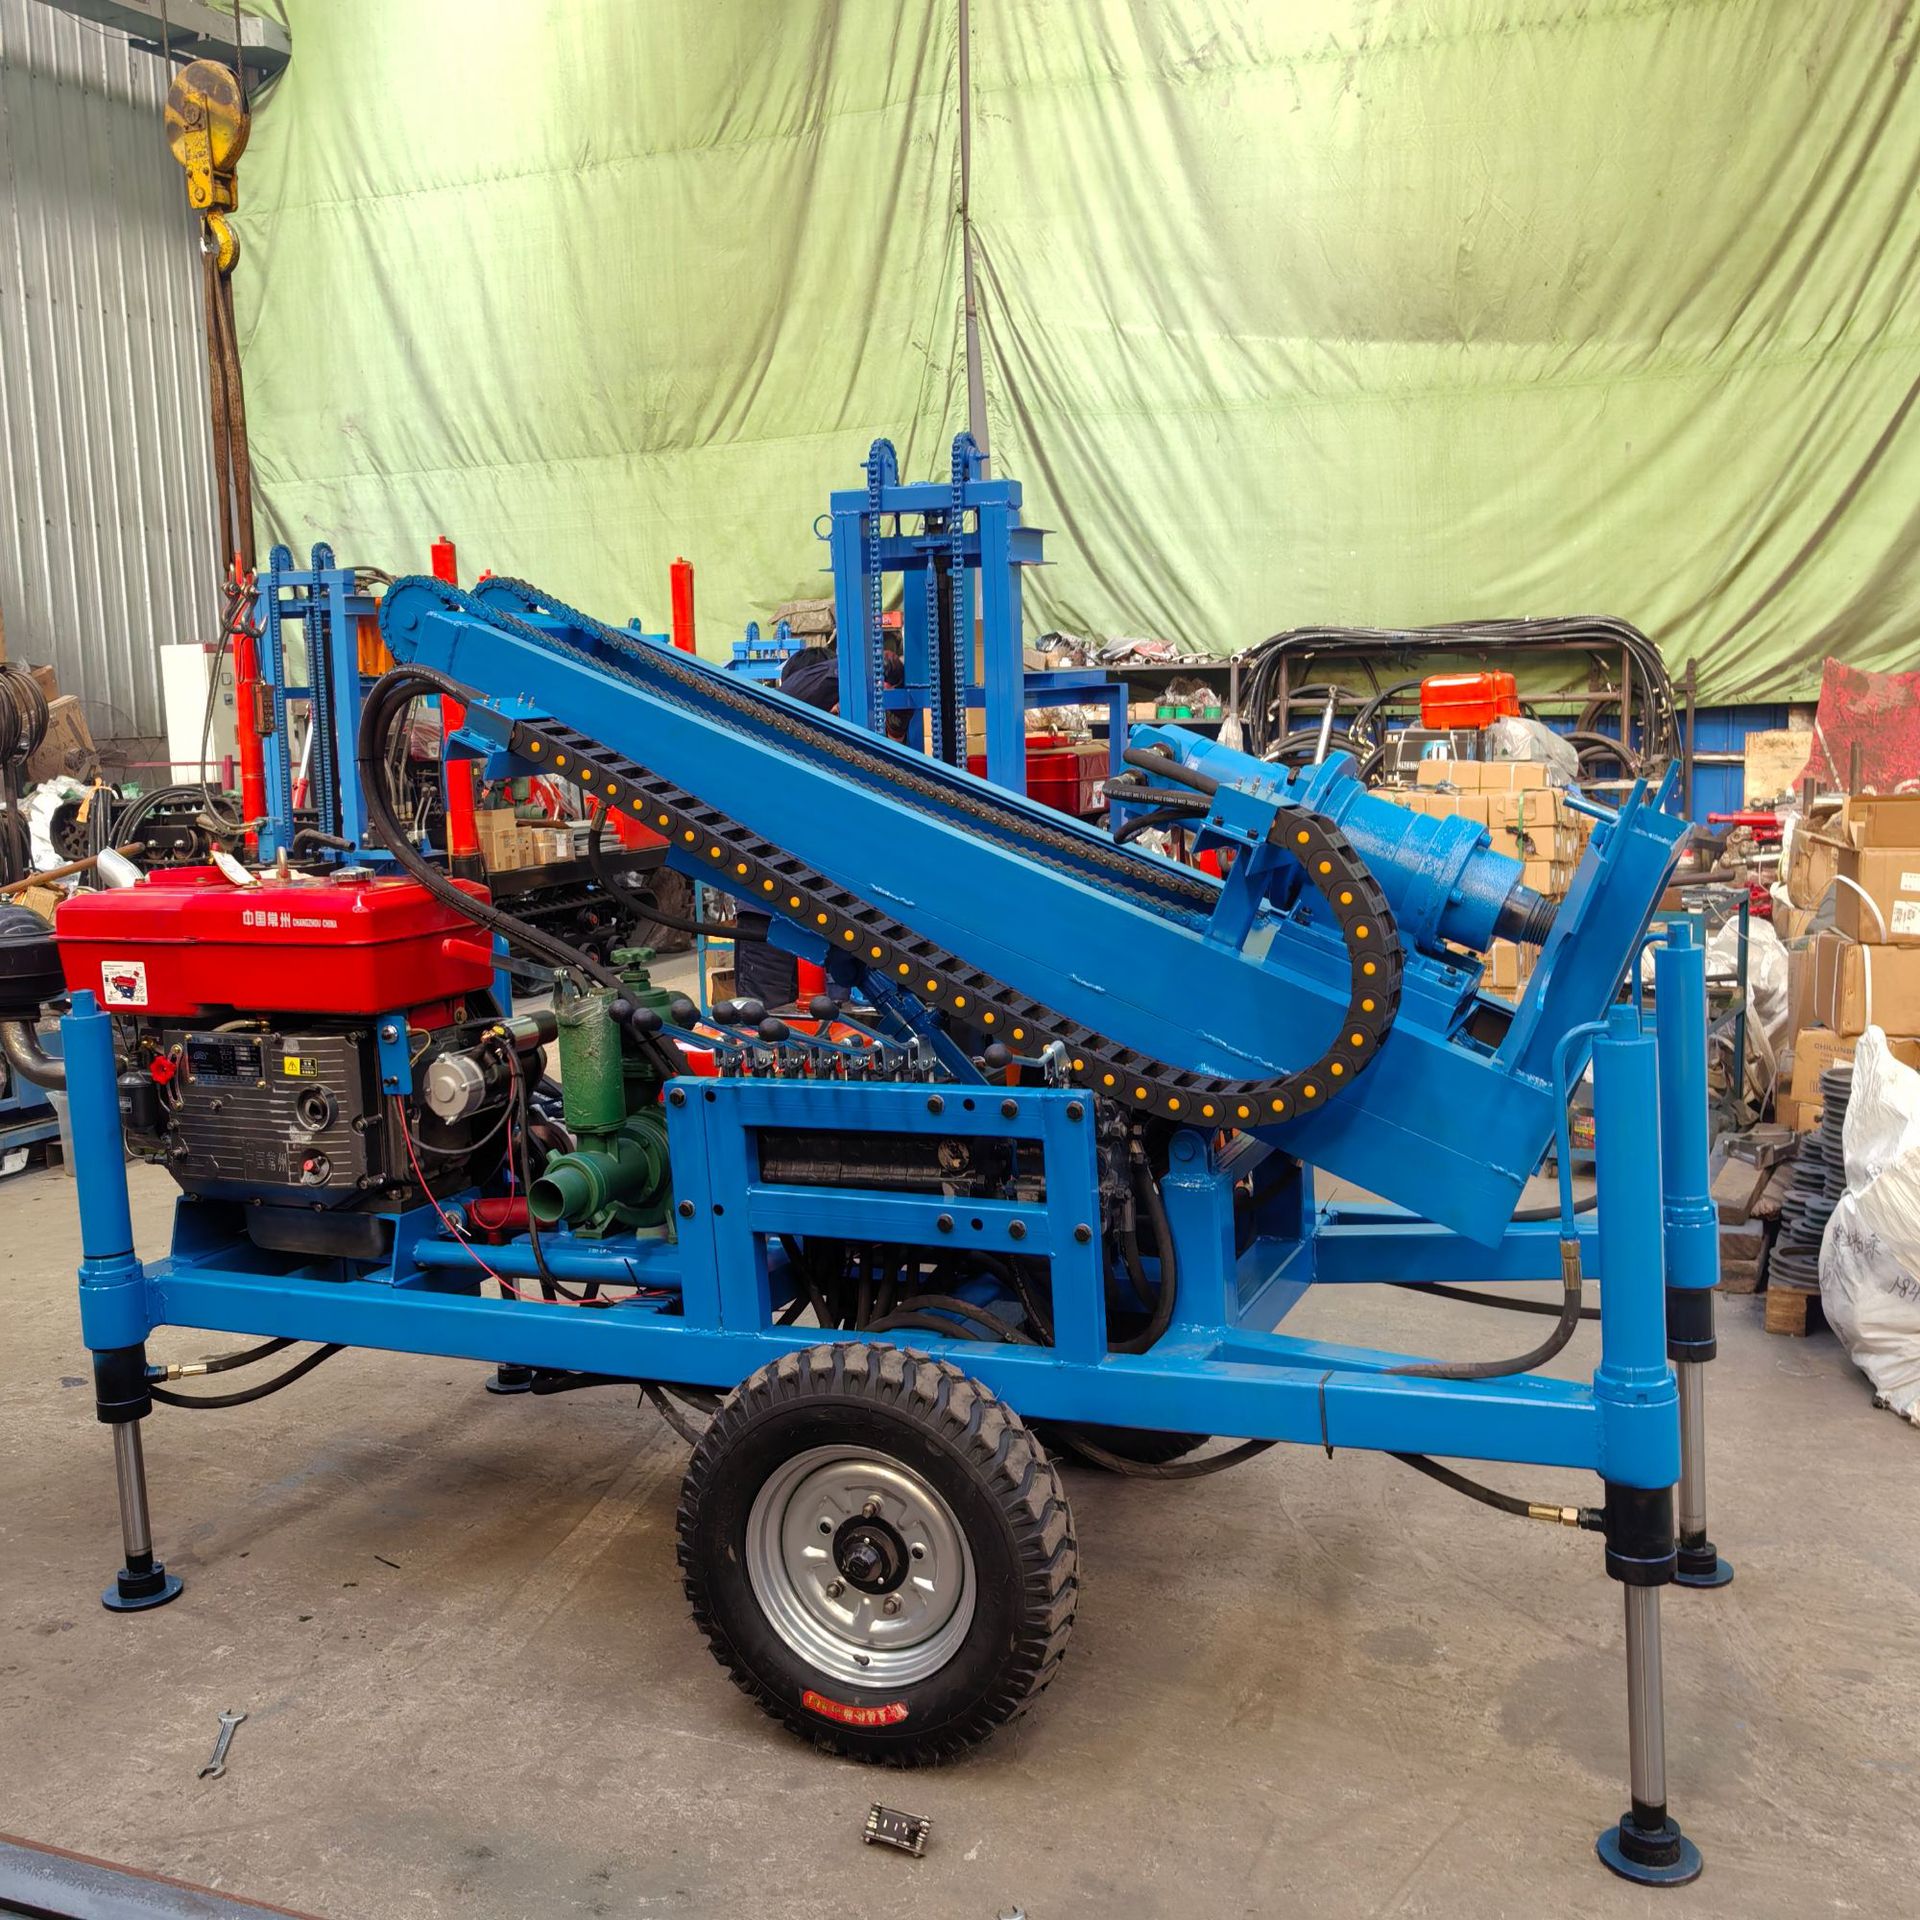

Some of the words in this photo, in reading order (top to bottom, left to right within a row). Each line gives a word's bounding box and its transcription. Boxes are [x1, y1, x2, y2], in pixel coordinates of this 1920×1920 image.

[242, 909, 291, 928] 中国常州
[322, 918, 337, 929] CHINA
